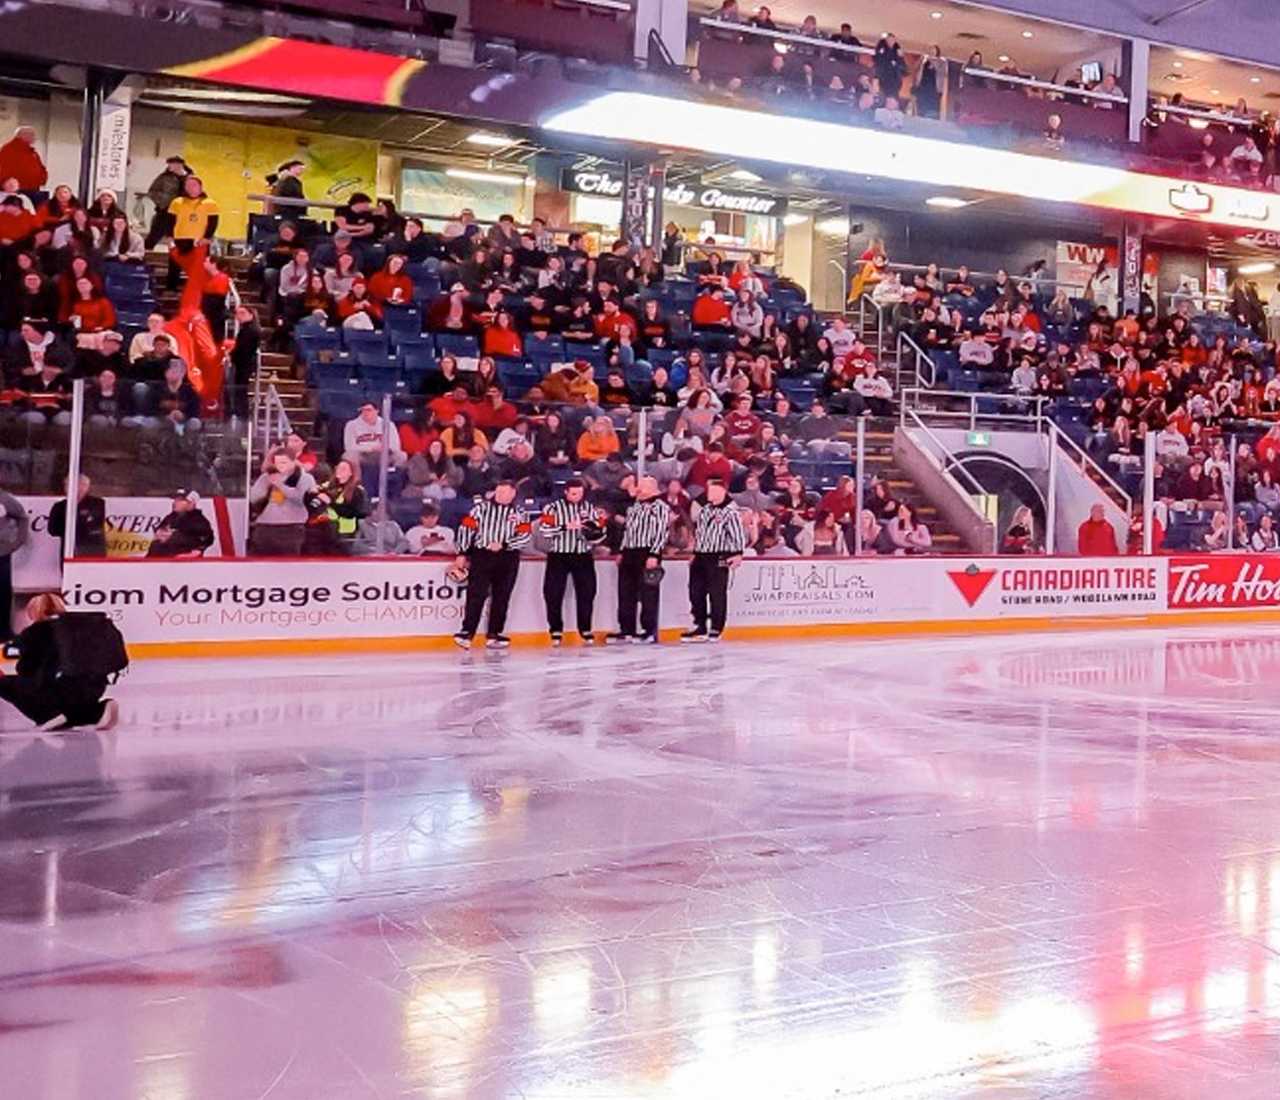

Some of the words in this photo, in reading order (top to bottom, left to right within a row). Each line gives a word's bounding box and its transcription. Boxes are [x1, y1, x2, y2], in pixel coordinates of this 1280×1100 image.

[574, 172, 623, 196] The
[700, 189, 776, 214] Counter
[1001, 569, 1110, 591] CANADIAN
[1113, 568, 1157, 589] TIRE
[1170, 564, 1227, 605] Tim
[158, 584, 331, 608] Mortgage
[341, 580, 468, 601] Solution
[154, 610, 213, 627] Your
[219, 608, 338, 627] Mortgage
[344, 604, 467, 622] CHAMPIO
